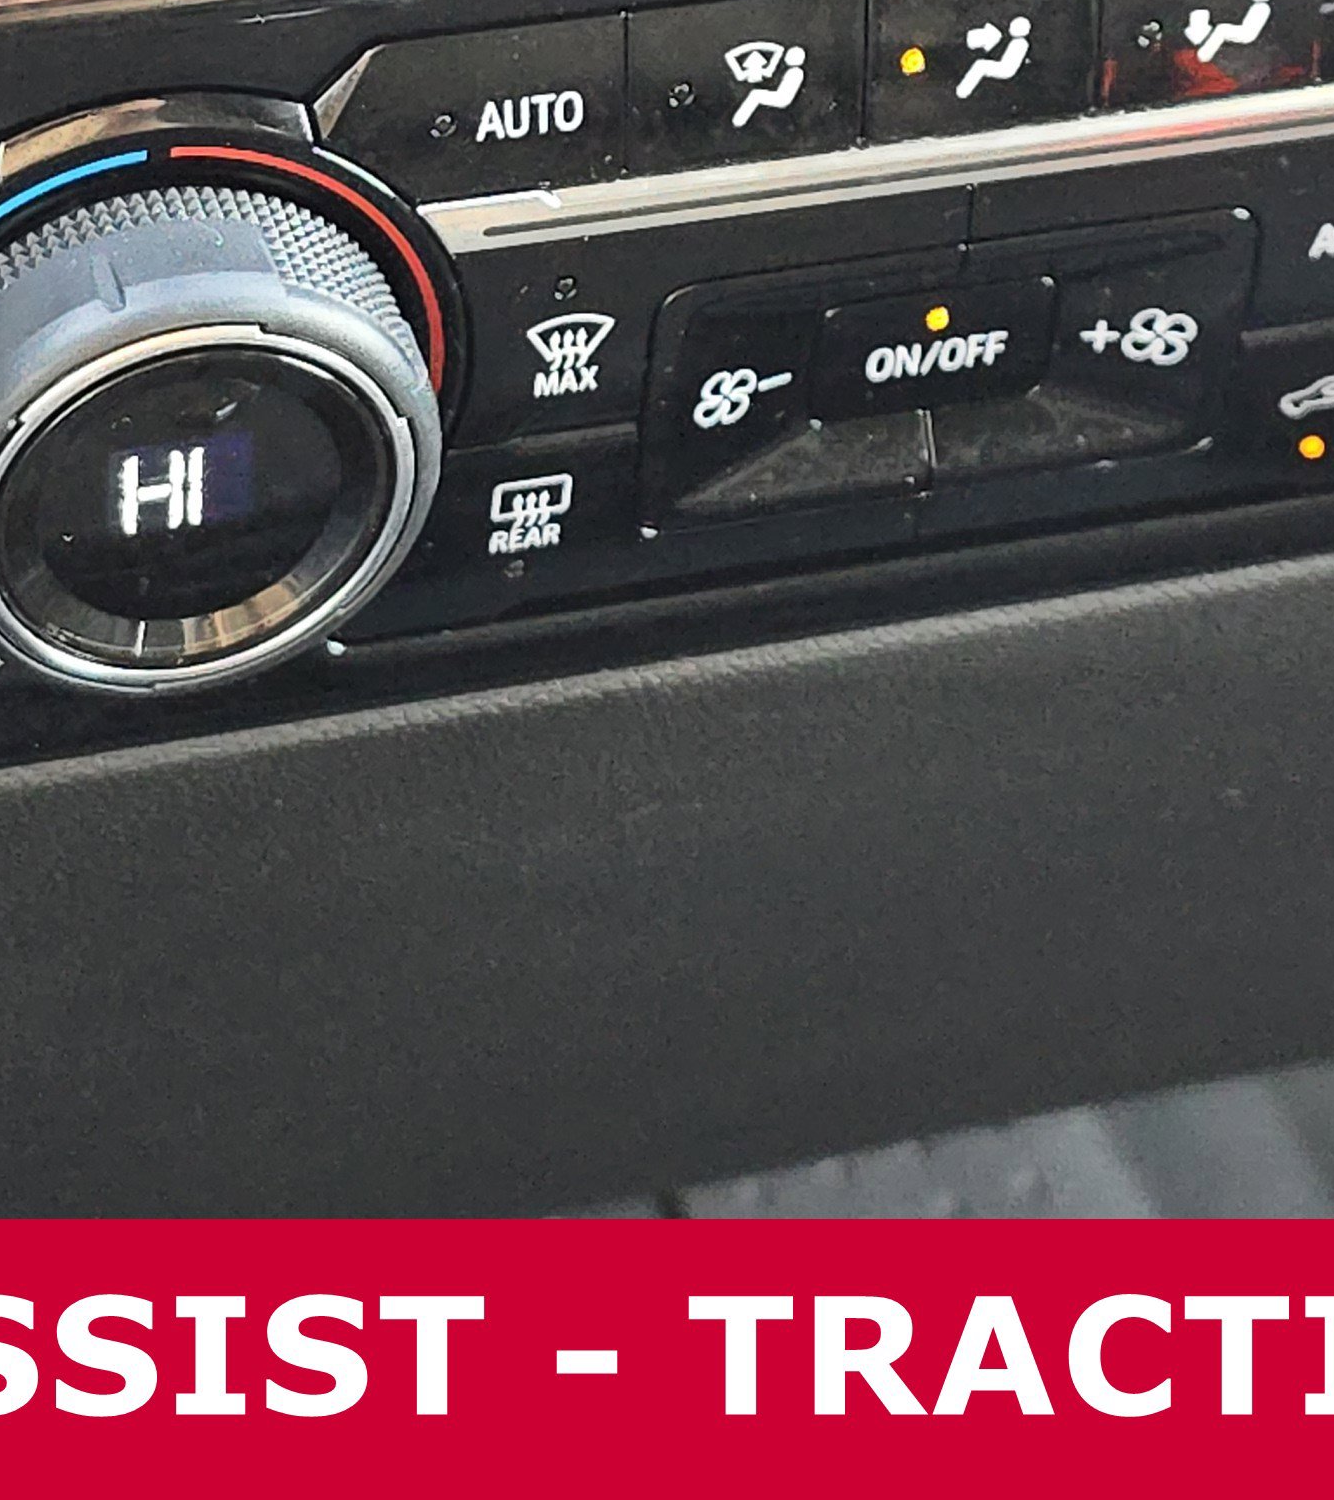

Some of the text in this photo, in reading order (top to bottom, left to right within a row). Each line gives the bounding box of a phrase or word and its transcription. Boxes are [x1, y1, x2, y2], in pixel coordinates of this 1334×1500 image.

[475, 90, 585, 143] AUTO
[533, 363, 599, 399] MAX
[865, 329, 1009, 383] ON/OFF
[117, 446, 205, 536] HI
[488, 521, 561, 555] REAR
